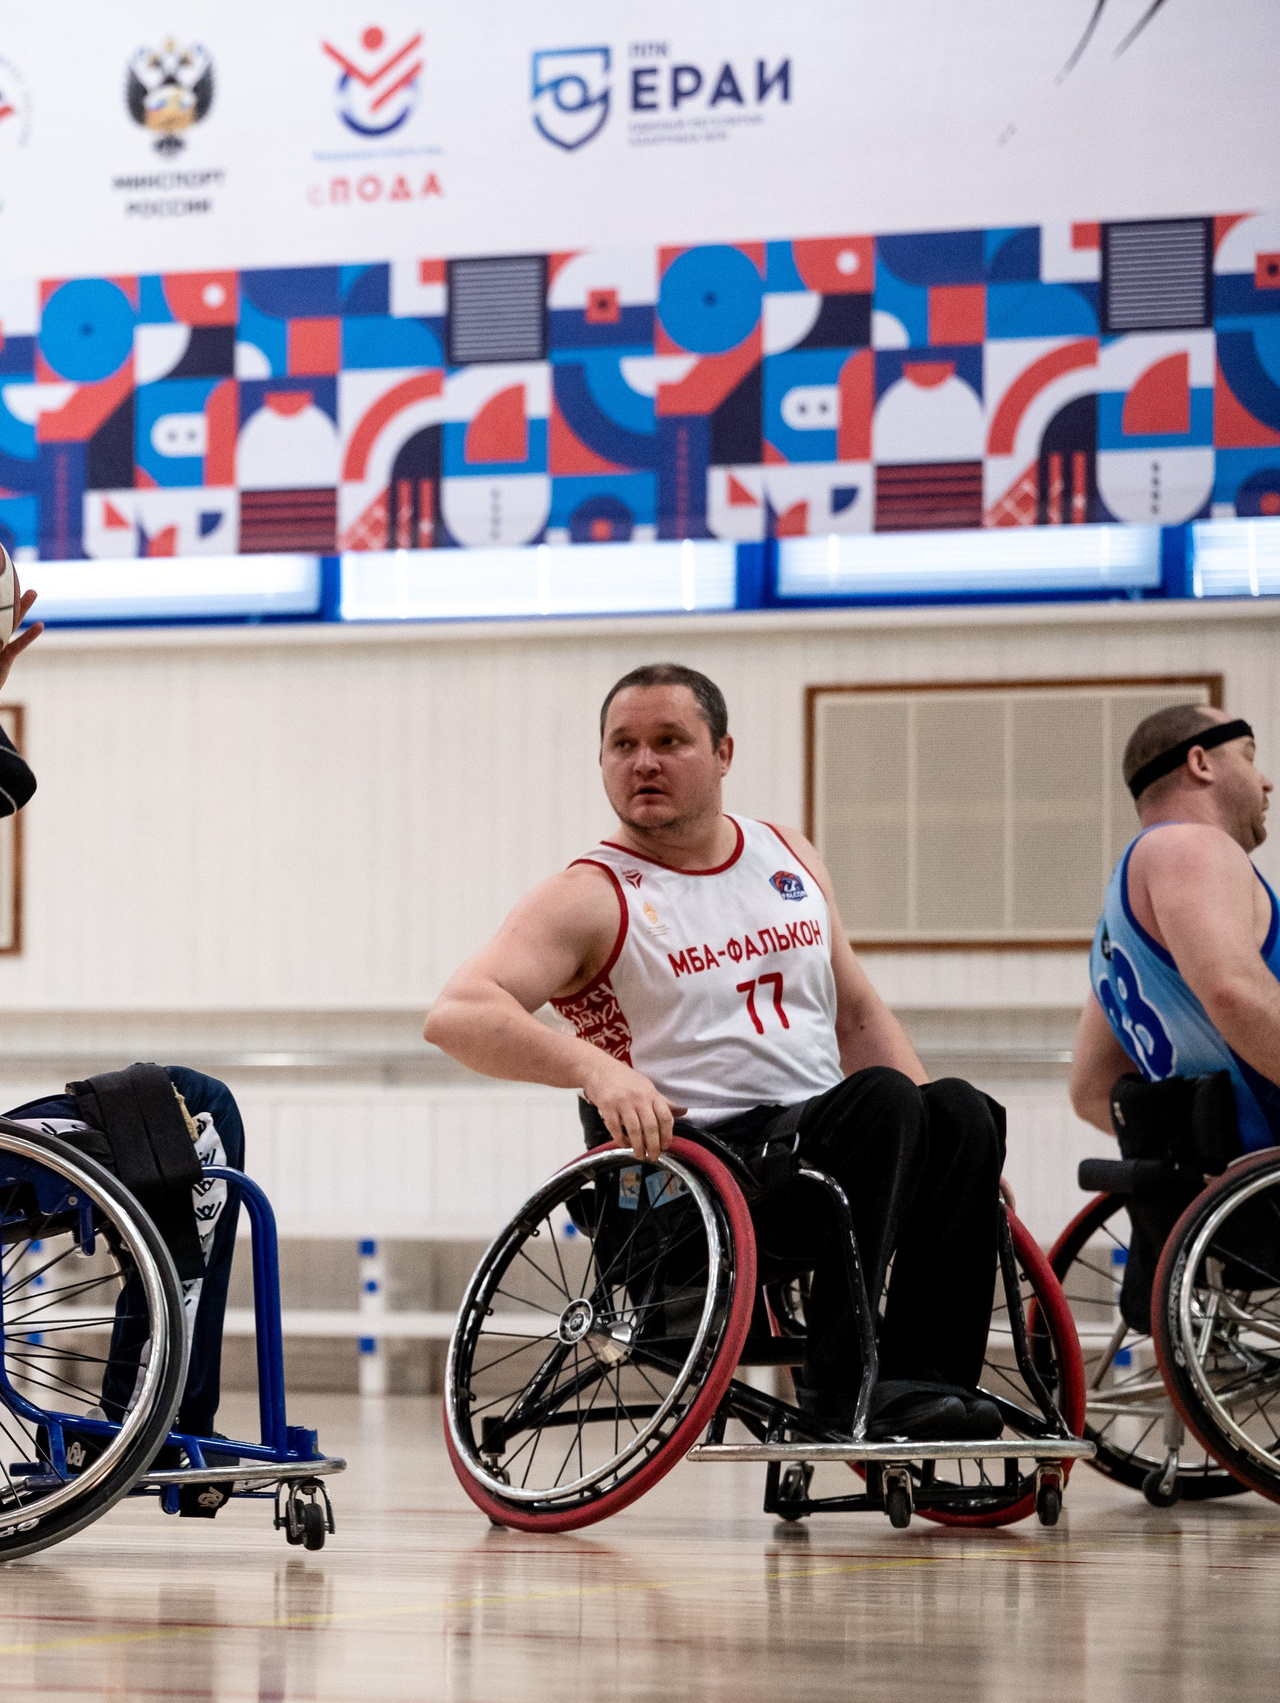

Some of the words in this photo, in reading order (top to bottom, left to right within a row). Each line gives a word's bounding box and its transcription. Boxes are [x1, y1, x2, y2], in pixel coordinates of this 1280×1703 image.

[631, 58, 792, 112] ЕРАИ
[667, 919, 824, 978] МБА-ФАЛЬКОН
[736, 971, 790, 1035] 77
